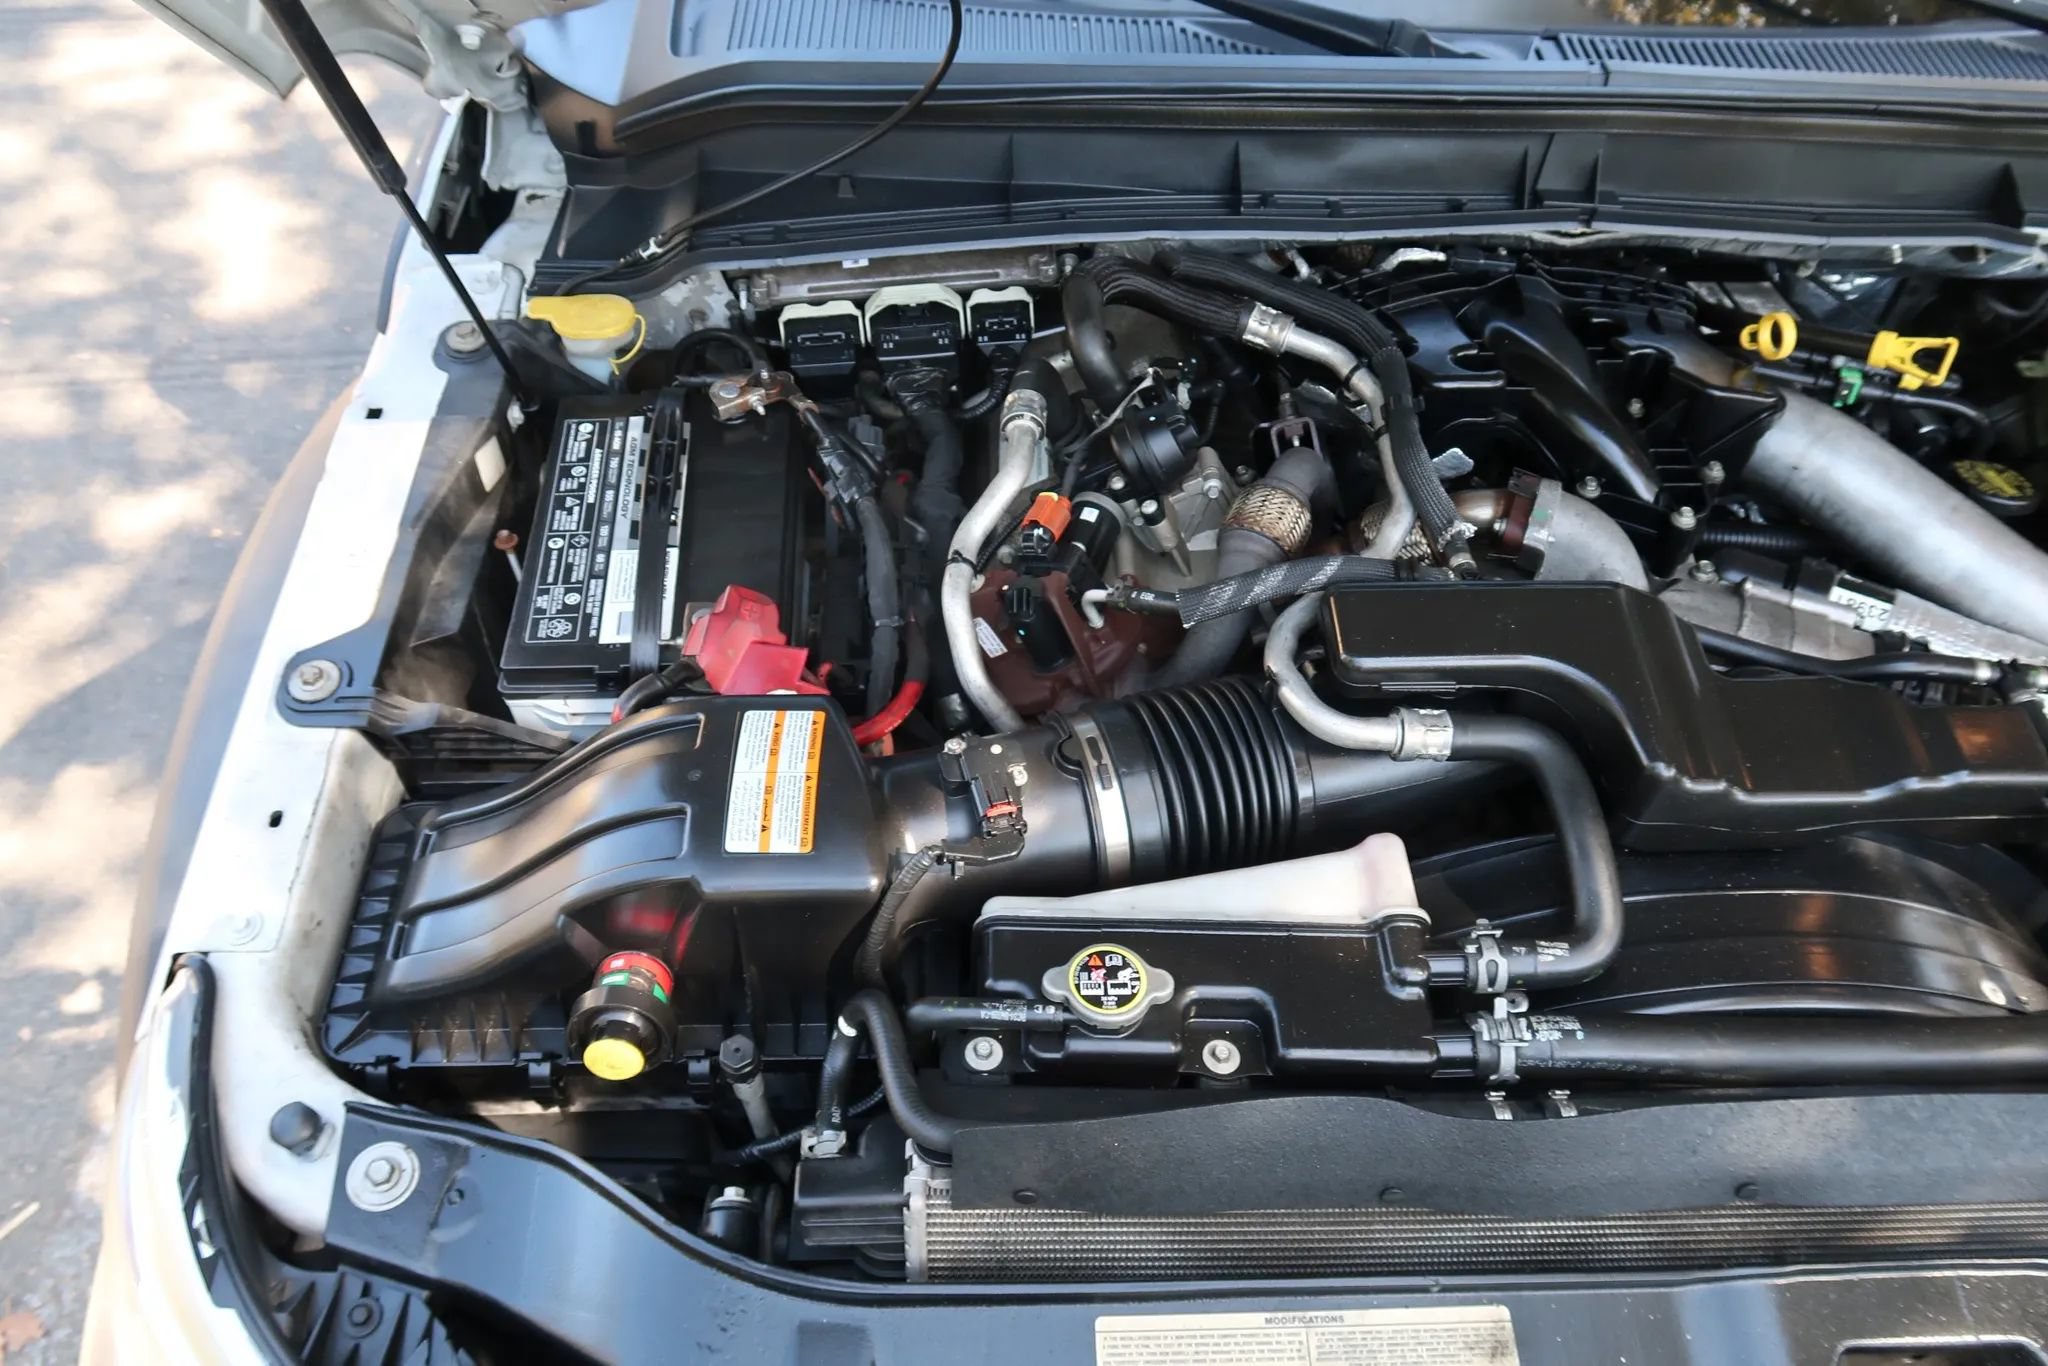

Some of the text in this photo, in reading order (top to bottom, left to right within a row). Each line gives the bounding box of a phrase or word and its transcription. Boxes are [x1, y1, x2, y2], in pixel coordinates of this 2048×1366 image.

[620, 437, 638, 519] AGM TECHNOLOGY
[802, 785, 812, 835] AVERTISSEMENT
[1265, 1315, 1344, 1325] MODIFICATIONS
